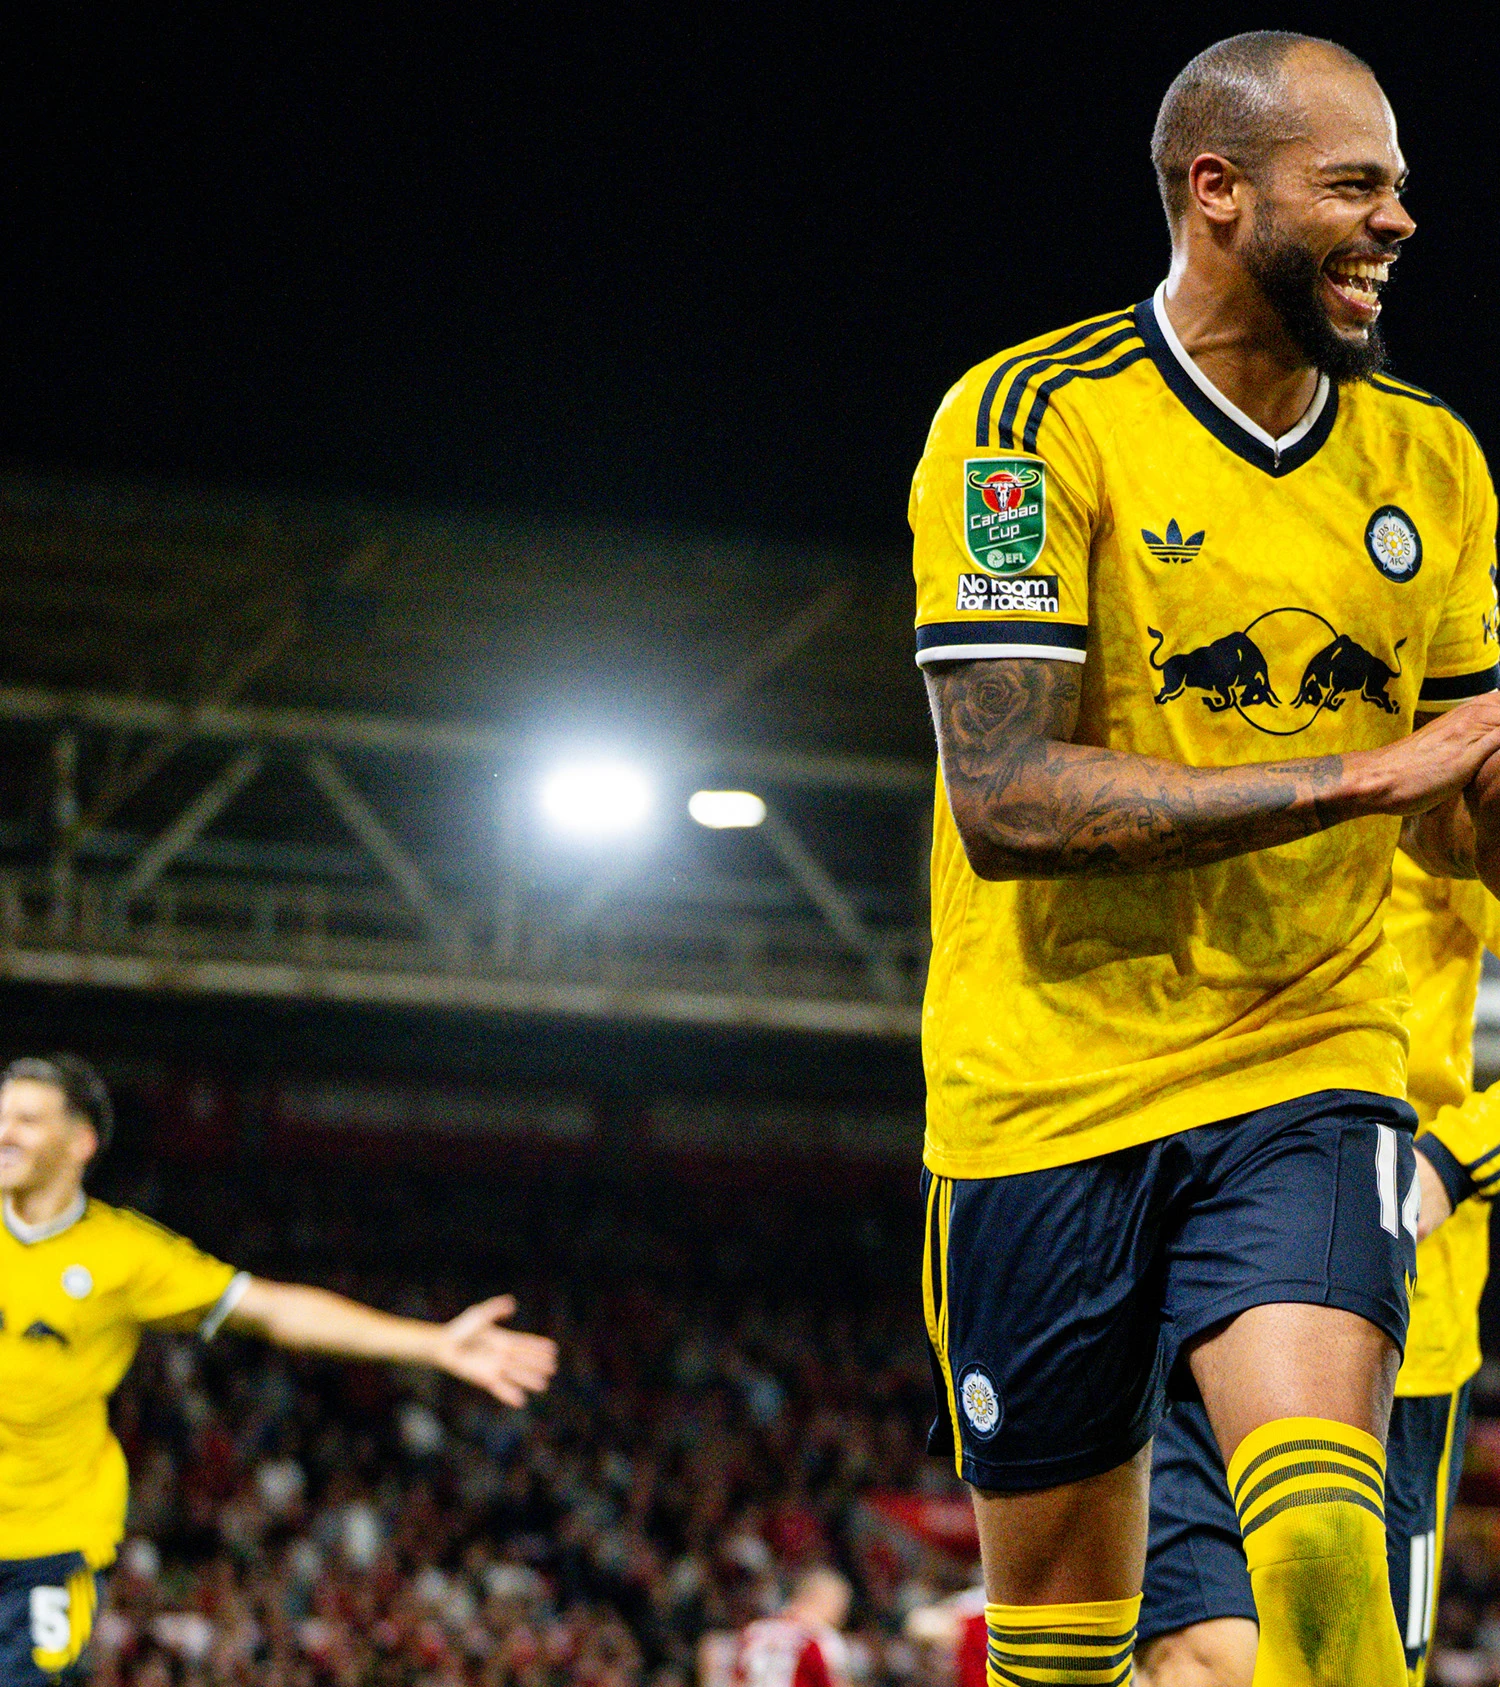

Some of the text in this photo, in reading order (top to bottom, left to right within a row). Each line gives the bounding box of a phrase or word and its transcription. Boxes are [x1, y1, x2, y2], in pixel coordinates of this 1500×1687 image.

[970, 503, 1039, 530] Carabao
[989, 524, 1020, 541] Cup
[1392, 524, 1411, 556] UNITED
[1005, 552, 1026, 564] EFL
[1389, 557, 1405, 566] AFC
[959, 574, 1049, 596] No room
[957, 591, 1059, 613] for racism
[29, 1585, 71, 1653] 5
